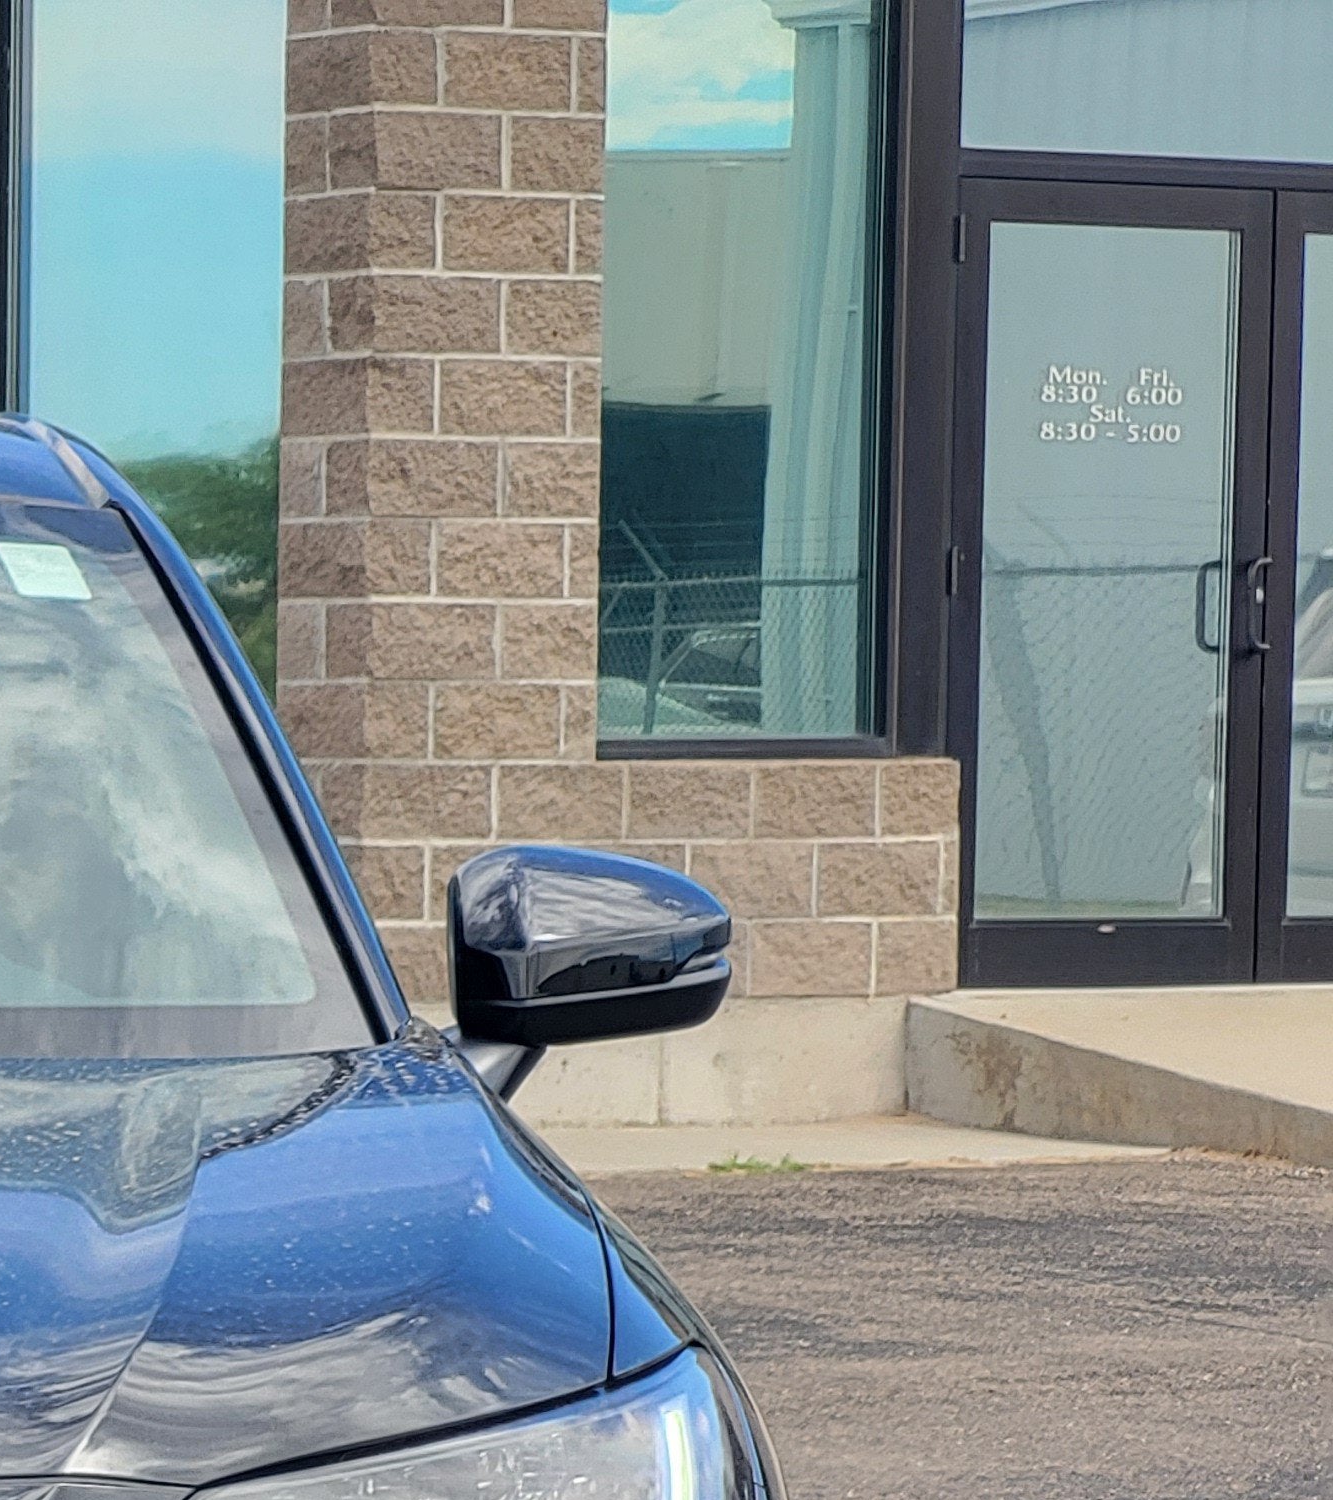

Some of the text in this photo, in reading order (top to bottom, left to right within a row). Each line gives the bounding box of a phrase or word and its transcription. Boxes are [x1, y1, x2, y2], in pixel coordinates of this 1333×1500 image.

[1048, 364, 1175, 387] Mon. Fri.
[1040, 384, 1183, 406] 8:30 6:00
[1088, 404, 1132, 424] Sat.
[1039, 421, 1097, 442] 8:30
[1126, 423, 1181, 444] 5:00
